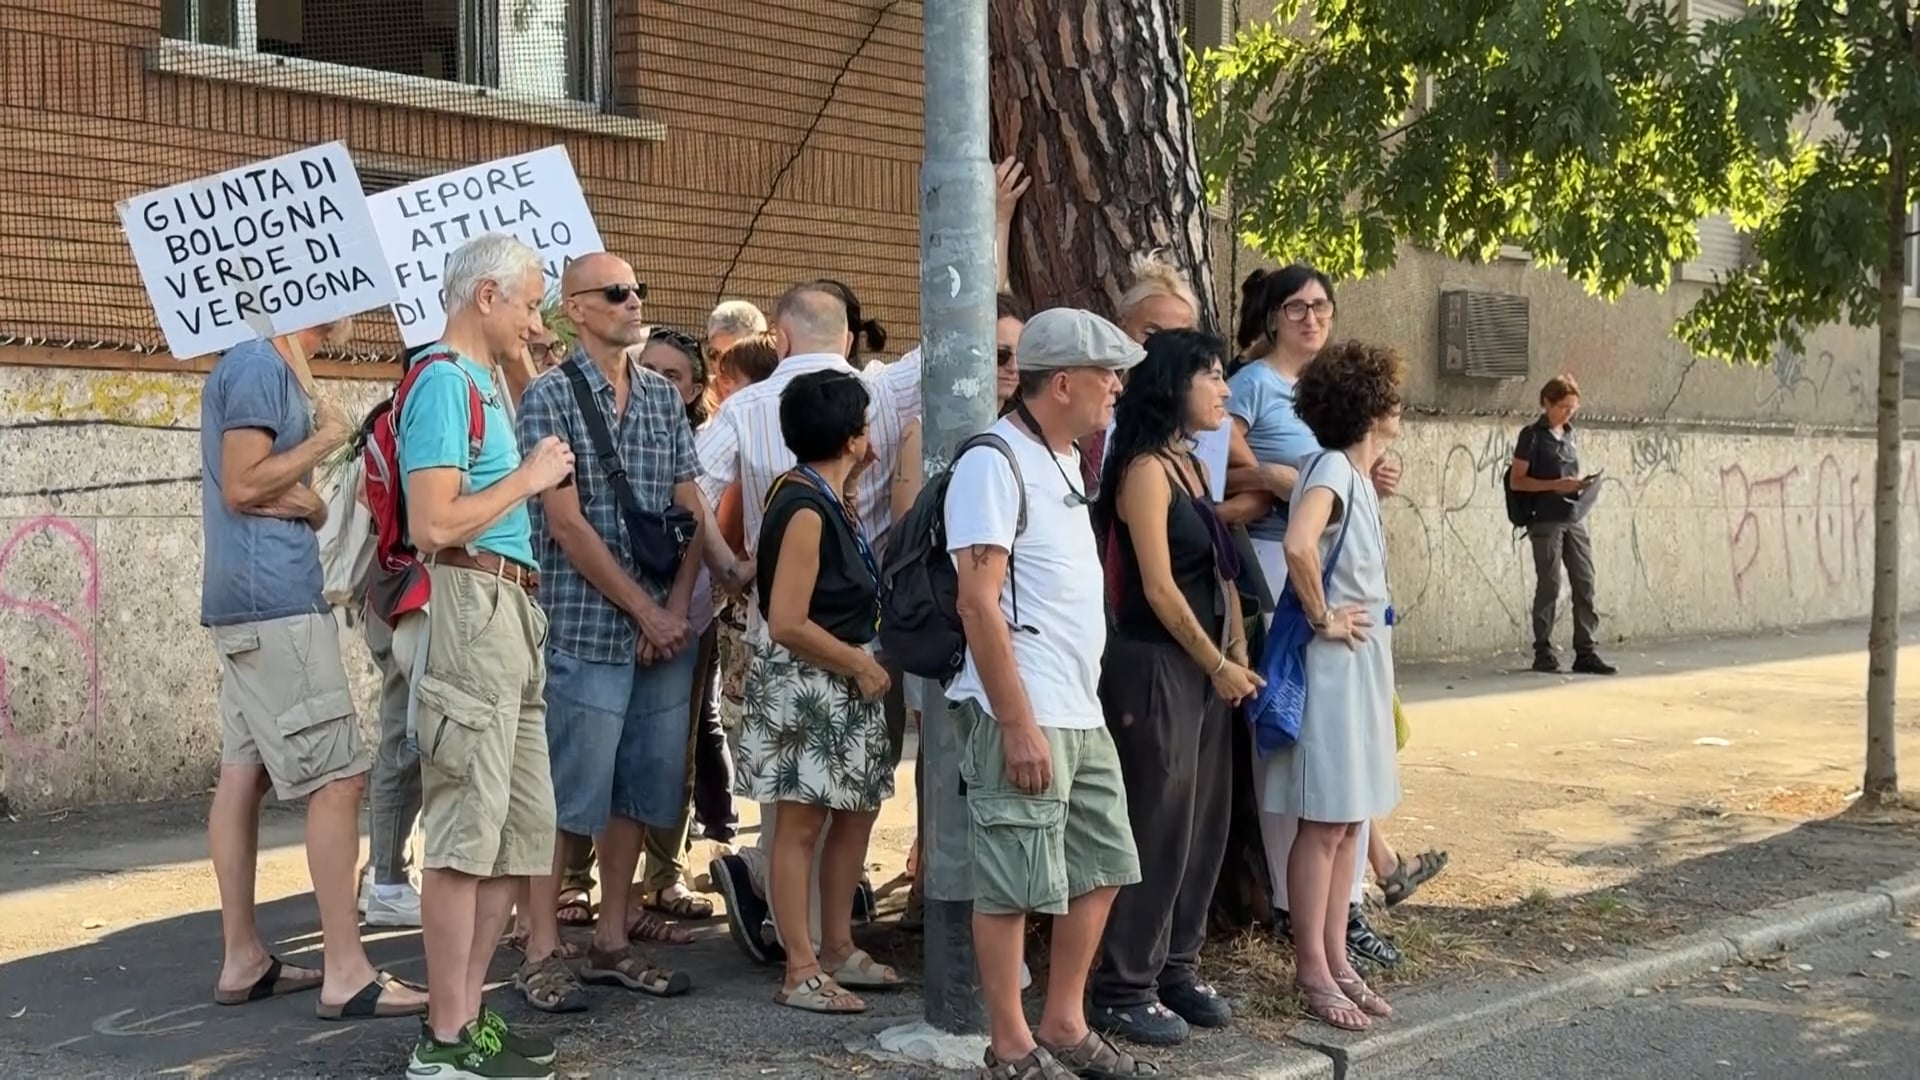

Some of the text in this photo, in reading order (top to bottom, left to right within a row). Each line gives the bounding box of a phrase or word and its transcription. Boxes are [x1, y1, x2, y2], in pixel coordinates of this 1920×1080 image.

[144, 157, 337, 232] GIUNTA DI
[397, 161, 535, 218] LEPORE
[165, 195, 344, 264] BOLOGNA
[412, 199, 541, 251] ATTILA
[165, 233, 341, 299] VERDE DI
[176, 266, 375, 335] VERGOGNA
[395, 297, 426, 326] DI
